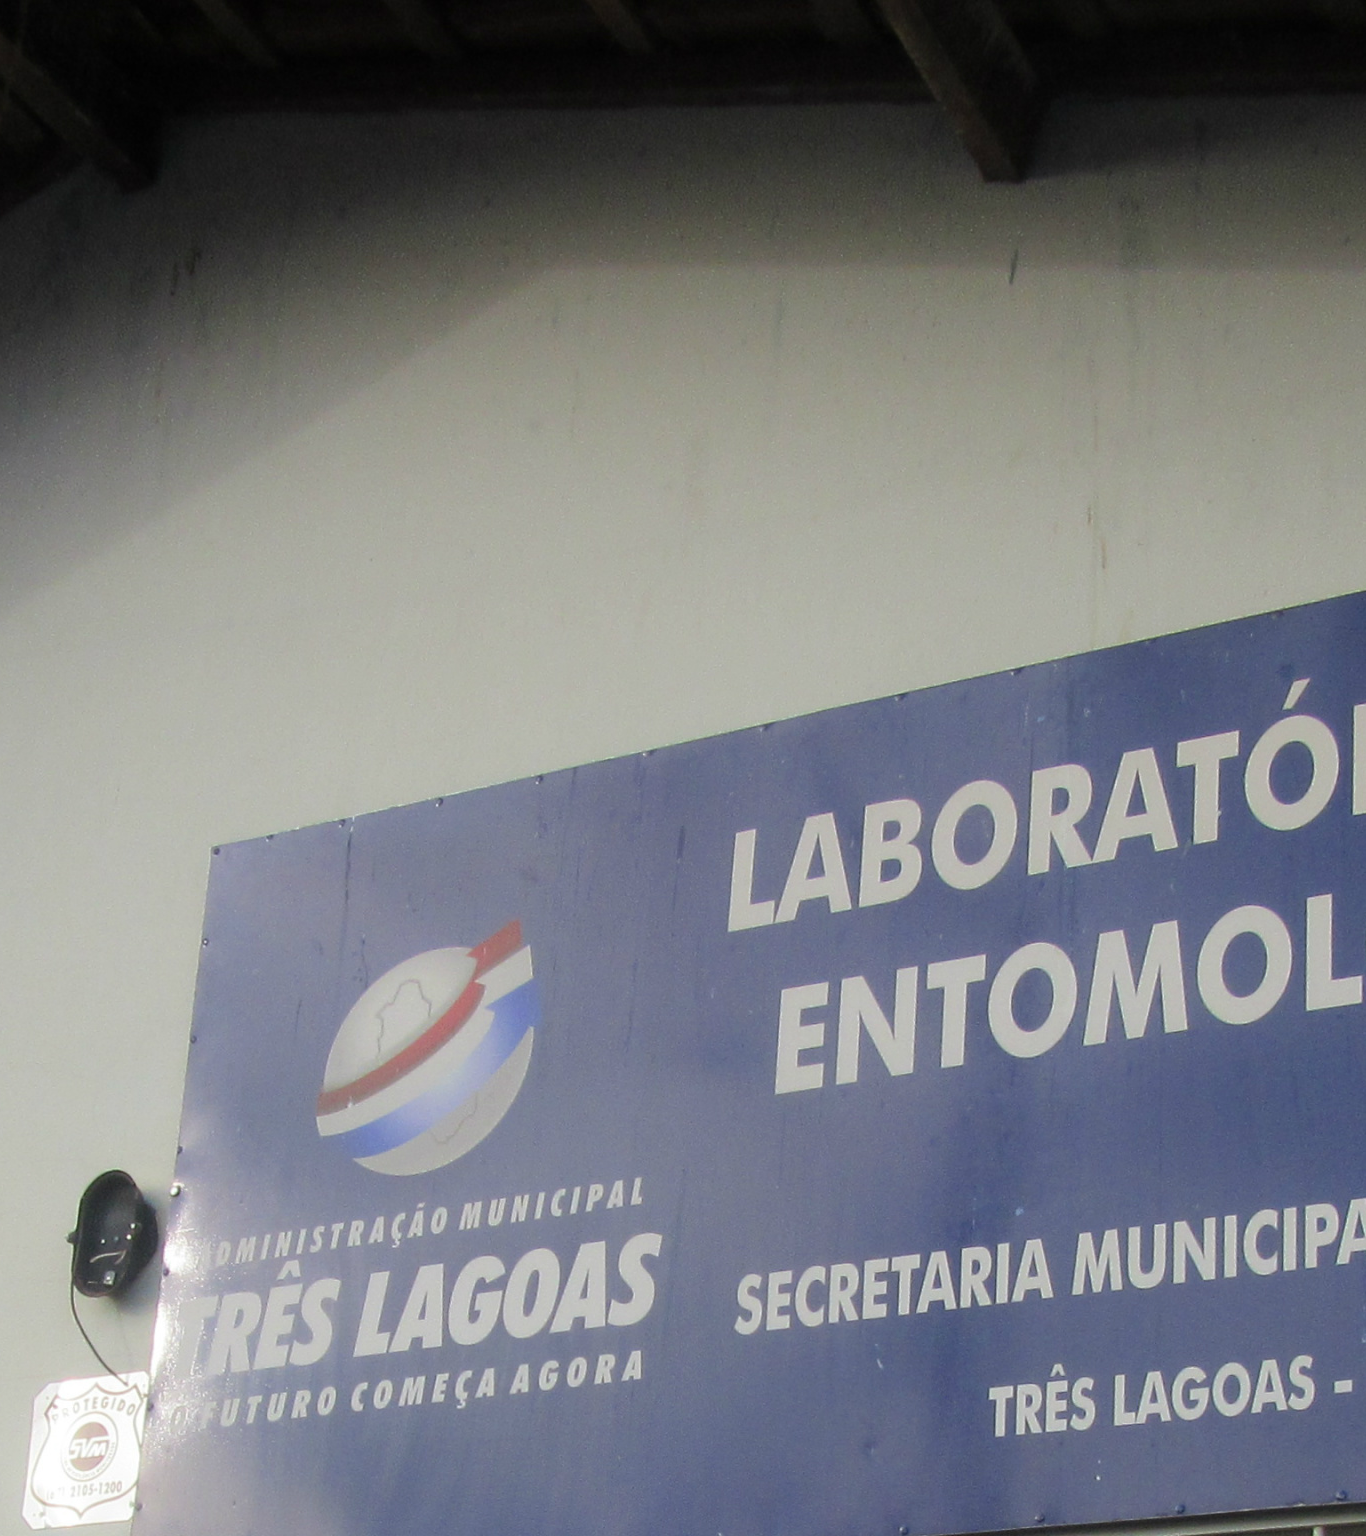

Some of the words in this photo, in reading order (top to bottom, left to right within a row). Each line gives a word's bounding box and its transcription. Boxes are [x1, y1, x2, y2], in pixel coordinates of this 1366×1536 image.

[458, 1177, 643, 1231] MUNICIPAL
[170, 1260, 341, 1379] TRÊS
[353, 1232, 663, 1358] LAGOAS
[733, 1238, 1054, 1336] SECRETARIA
[51, 1396, 137, 1425] PROTEGIDO
[199, 1386, 337, 1429] FUTURO
[350, 1367, 495, 1410] COMEÇA
[509, 1349, 642, 1395] AGORA
[988, 1364, 1096, 1438] TRÊS
[1113, 1354, 1316, 1428] LAGOAS
[1334, 1379, 1354, 1394] -
[68, 1436, 111, 1460] SVM
[70, 1480, 123, 1498] 2105-1200
